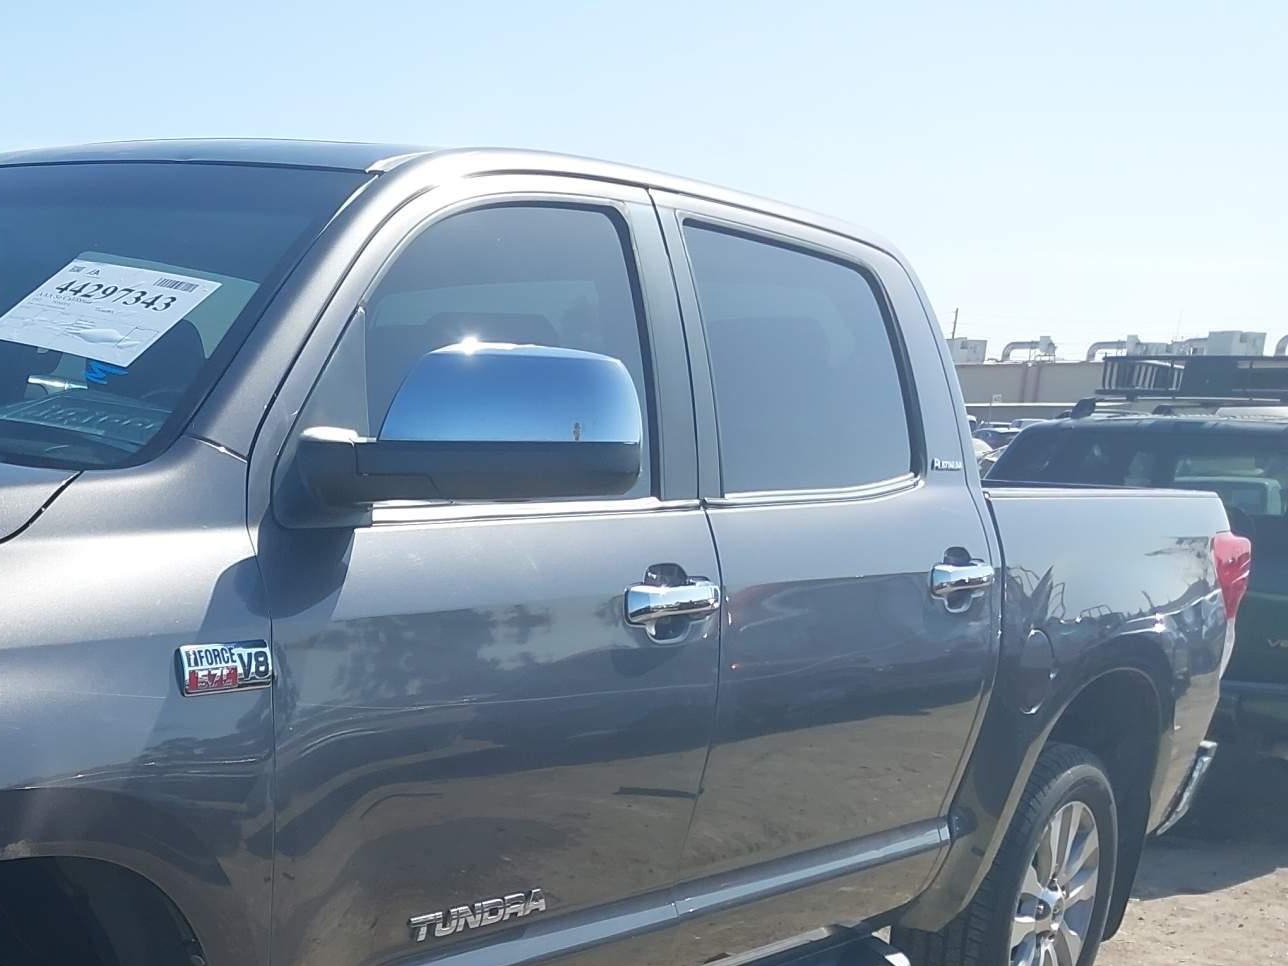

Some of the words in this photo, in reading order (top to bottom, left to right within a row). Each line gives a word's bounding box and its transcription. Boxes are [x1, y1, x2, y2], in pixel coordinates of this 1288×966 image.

[55, 280, 177, 312] 44297343
[237, 650, 270, 681] V8
[408, 887, 547, 943] TUNDRA
